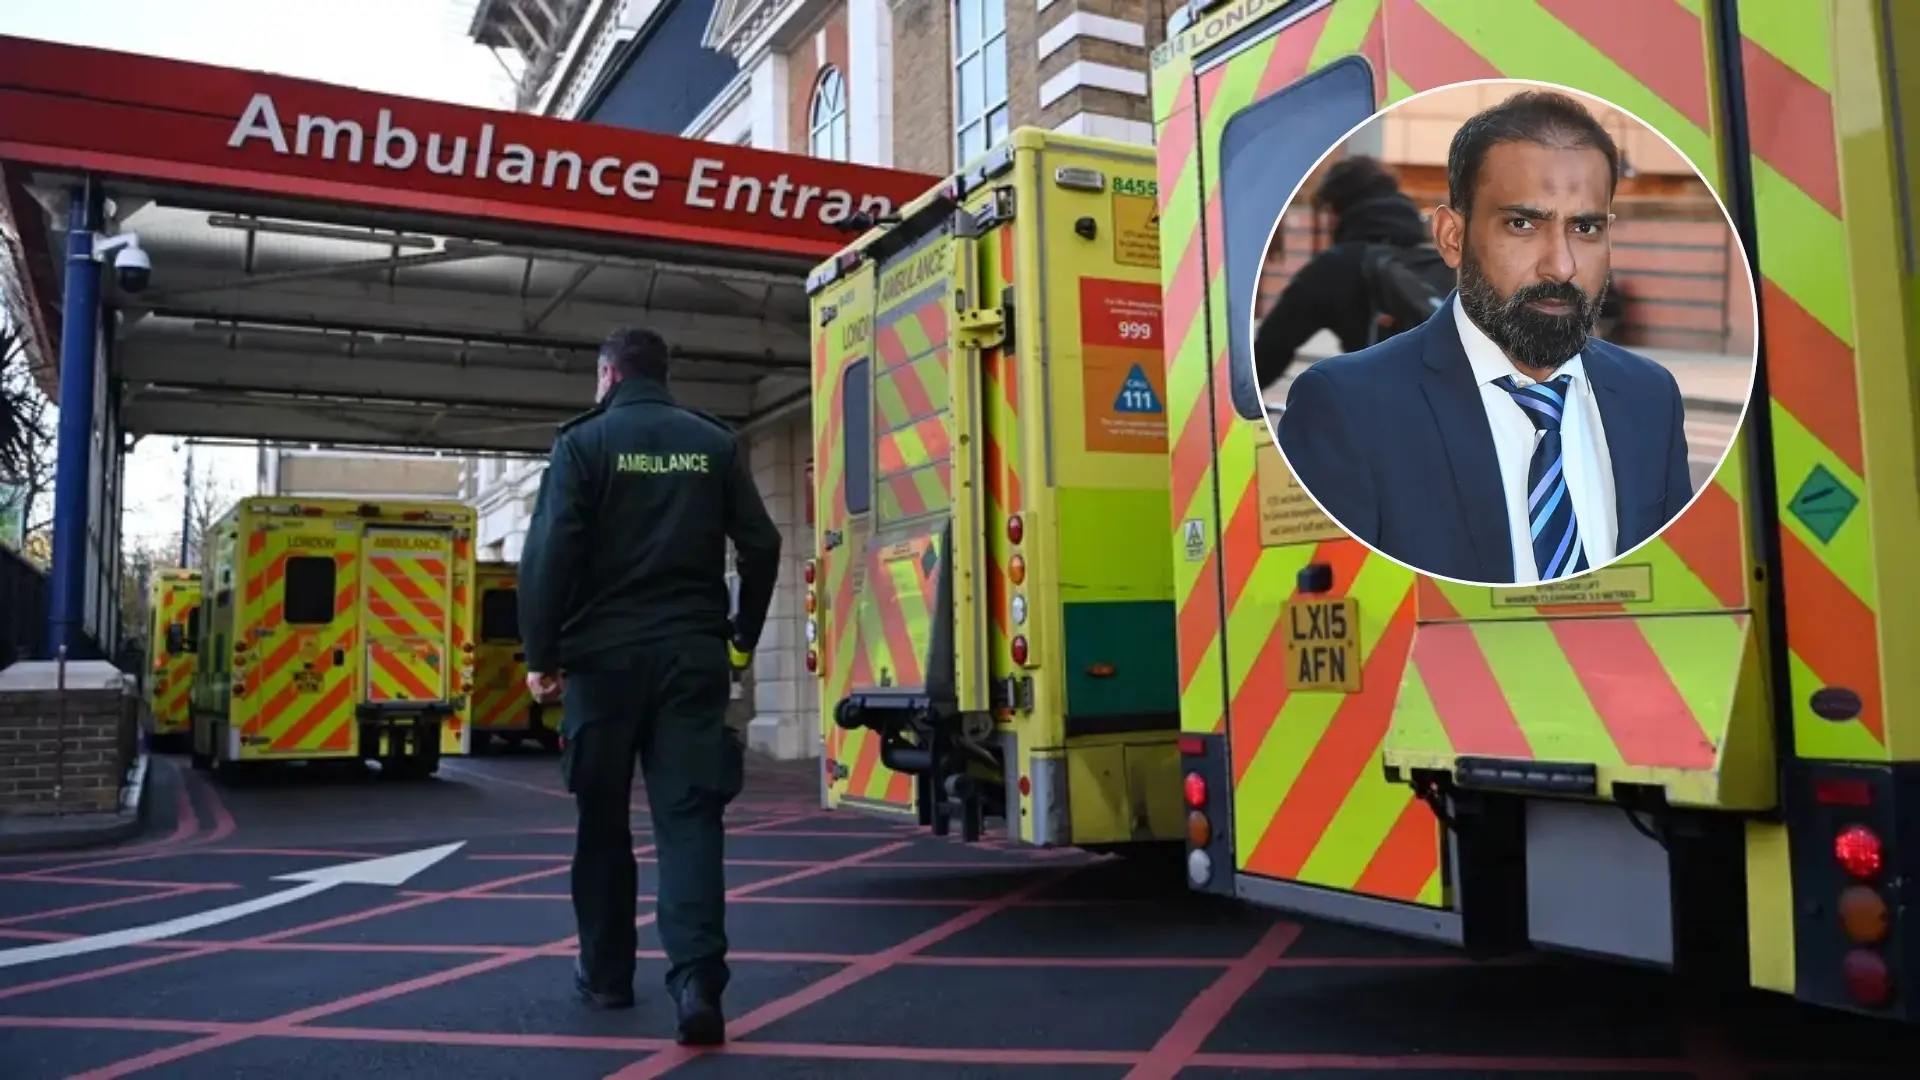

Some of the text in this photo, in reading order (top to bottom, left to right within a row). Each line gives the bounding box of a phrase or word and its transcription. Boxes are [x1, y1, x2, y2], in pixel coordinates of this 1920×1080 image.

[1191, 0, 1277, 48] LOND
[227, 92, 893, 226] Ambulance Entran
[1113, 177, 1157, 195] 8455
[881, 243, 947, 304] AMBULANCE
[1118, 321, 1151, 339] 999
[1123, 390, 1152, 409] 111
[616, 452, 709, 474] AMBULANCE
[287, 536, 337, 549] LONDON
[373, 536, 441, 550] AMBULANCE
[1291, 603, 1347, 639] LX15
[1299, 646, 1345, 682] AFN
